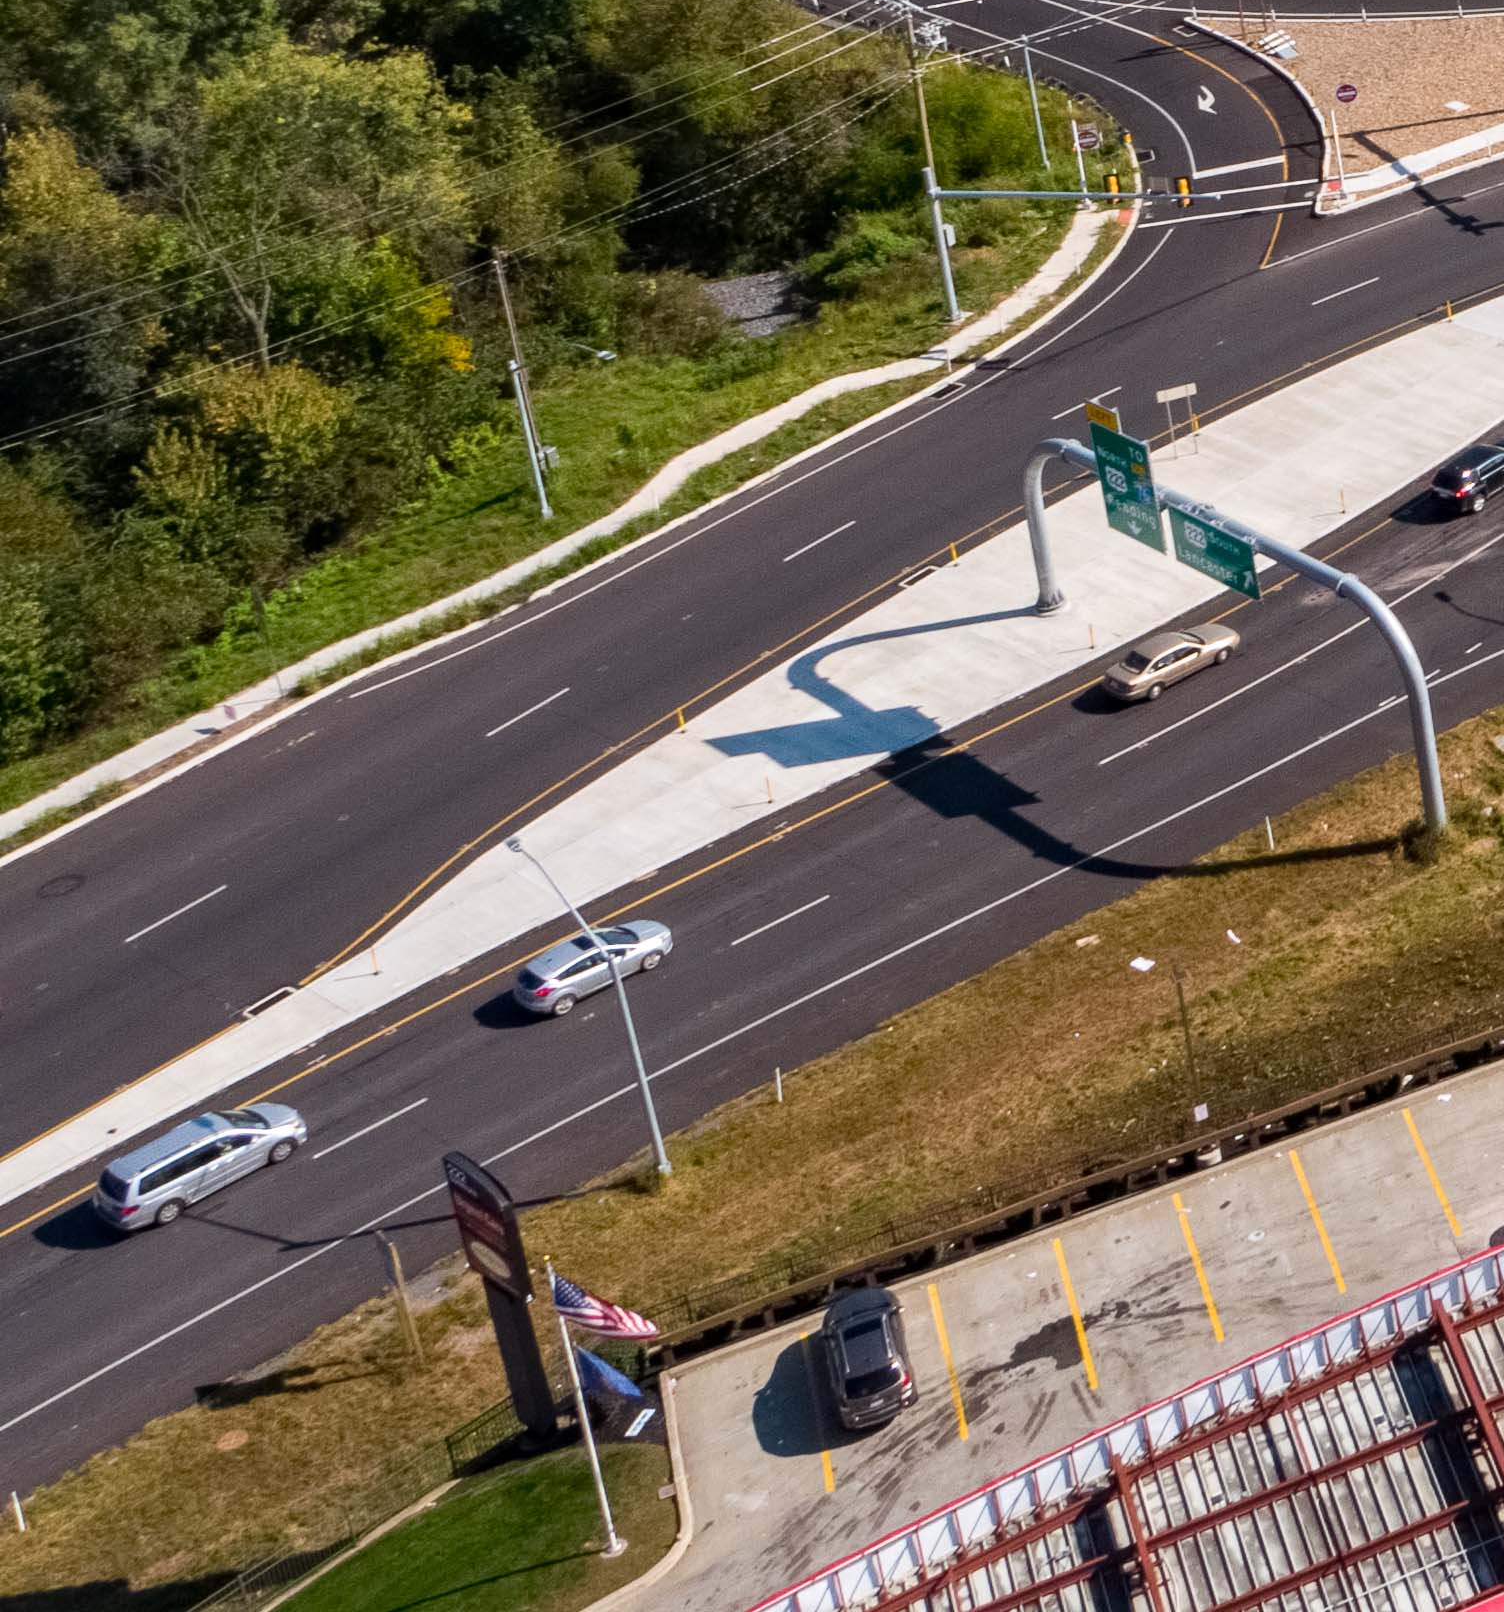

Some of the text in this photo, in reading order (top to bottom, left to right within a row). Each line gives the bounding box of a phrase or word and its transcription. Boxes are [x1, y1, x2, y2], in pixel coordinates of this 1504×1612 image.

[1127, 446, 1143, 463] TO
[1108, 472, 1126, 491] 222
[1178, 545, 1239, 584] Lancaster
